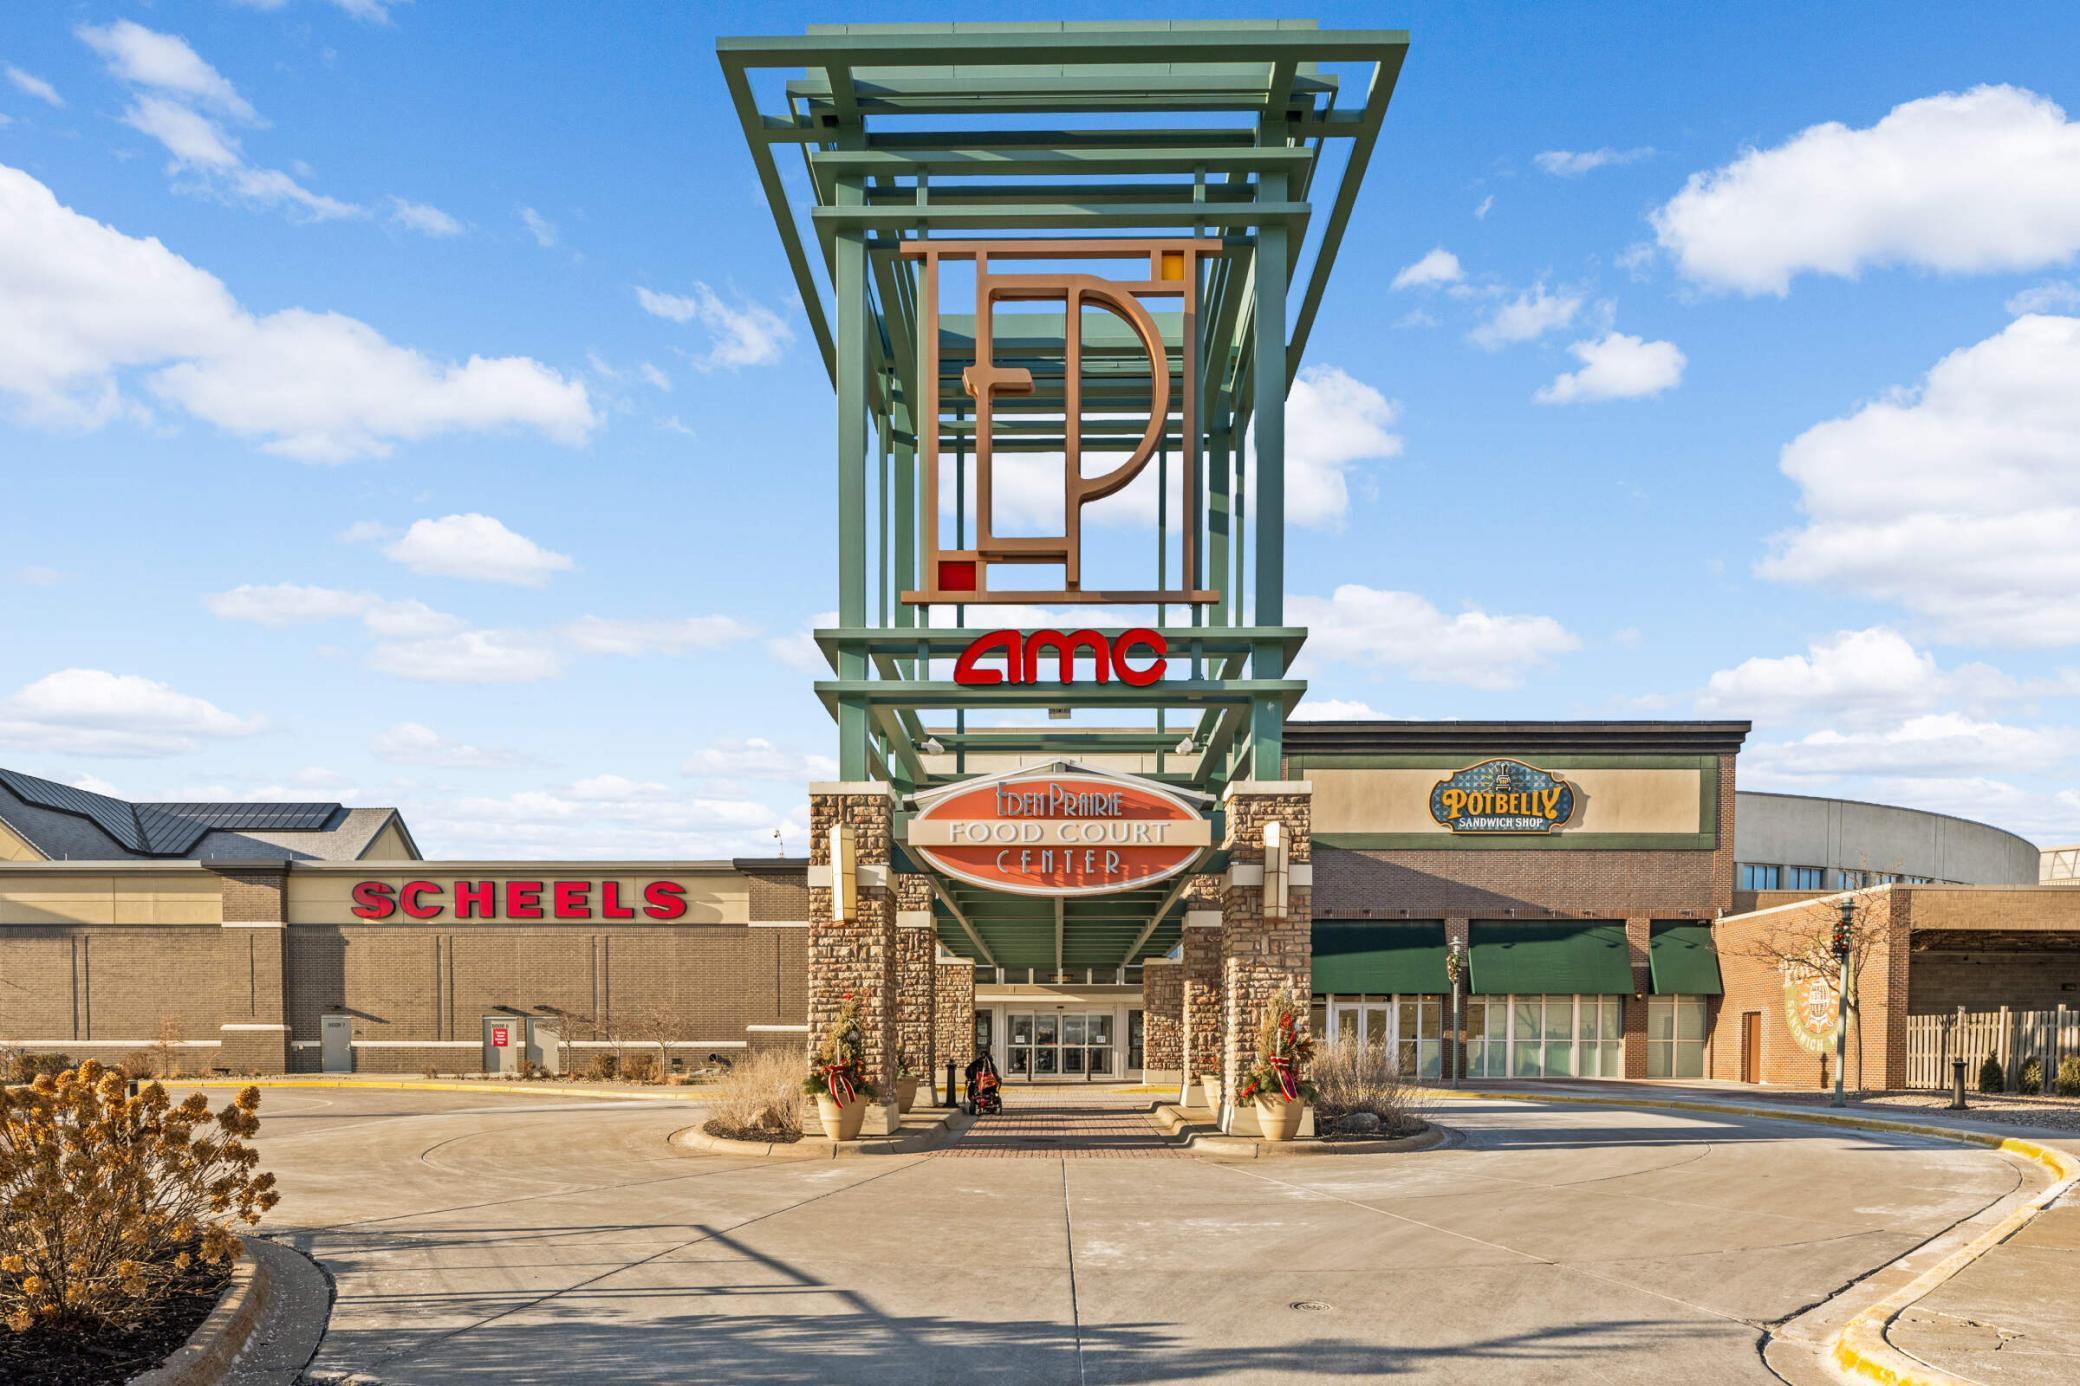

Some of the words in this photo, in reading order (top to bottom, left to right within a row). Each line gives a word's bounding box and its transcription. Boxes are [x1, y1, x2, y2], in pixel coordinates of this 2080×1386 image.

[995, 781, 1045, 817] EDEN
[1049, 783, 1123, 817] PRAIRIE
[1442, 786, 1562, 820] POTBELLY
[949, 822, 1044, 843] FOOD
[1057, 822, 1172, 843] COURT
[1459, 817, 1514, 828] SANDWICH
[1515, 817, 1544, 828] SHOP
[996, 849, 1120, 874] CENTER
[350, 880, 688, 920] SCHEELS
